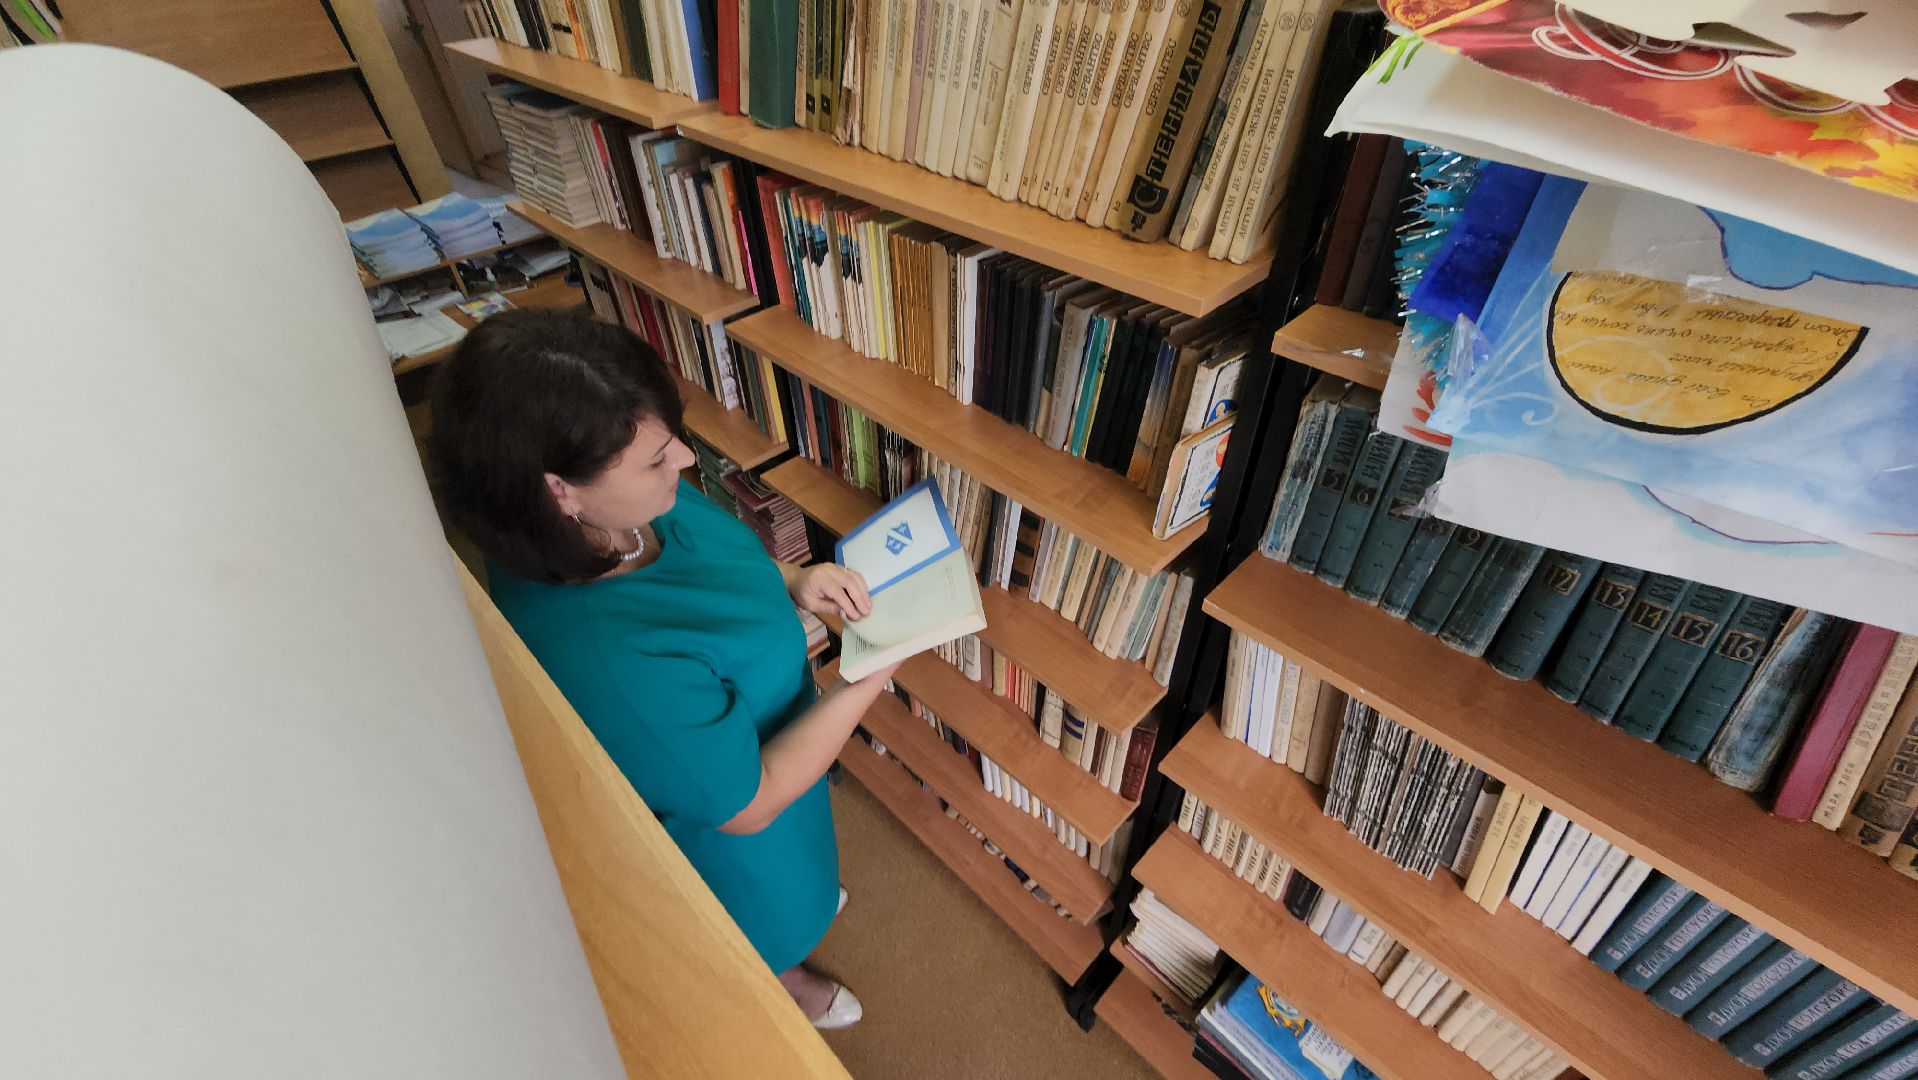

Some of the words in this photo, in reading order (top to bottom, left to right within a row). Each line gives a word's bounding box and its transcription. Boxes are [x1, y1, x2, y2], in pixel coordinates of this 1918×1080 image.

[1041, 24, 1062, 96] СЕРВАНТЕС
[1055, 21, 1078, 94] СЕРВАНТЕС
[1066, 25, 1091, 99] СЕРВАНТЕС
[1077, 32, 1103, 106] СЕРВАНТЕС
[1090, 31, 1117, 106] СЕРВАНТЕС
[1111, 32, 1140, 107] СЕРВАНТЕС
[1123, 32, 1153, 109] СЕРВАНТЕС
[1145, 38, 1177, 116] СЕРВАНТЕС
[1248, 17, 1270, 73] АНТУАН
[1128, 2, 1222, 215] СТЕНДАЛЬ
[1238, 73, 1250, 94] ДЕ
[1219, 192, 1237, 236] АНТУАН
[1231, 173, 1243, 192] ДЕ
[1238, 68, 1275, 172] СЕНТ-ЭКЗЮПЕРИ
[1239, 198, 1256, 239] АНТУАН
[1250, 178, 1262, 195] ДЕ
[1257, 68, 1295, 174] СЕНТ-ЭКЗЮПЕРИ
[1333, 417, 1365, 465] БАЛЬЗАК
[1550, 568, 1573, 591] 12
[1601, 582, 1628, 608] 13
[1637, 601, 1663, 629] 14
[1678, 617, 1711, 641] 15
[1727, 635, 1754, 660] 16
[1823, 792, 1842, 819] МАРК
